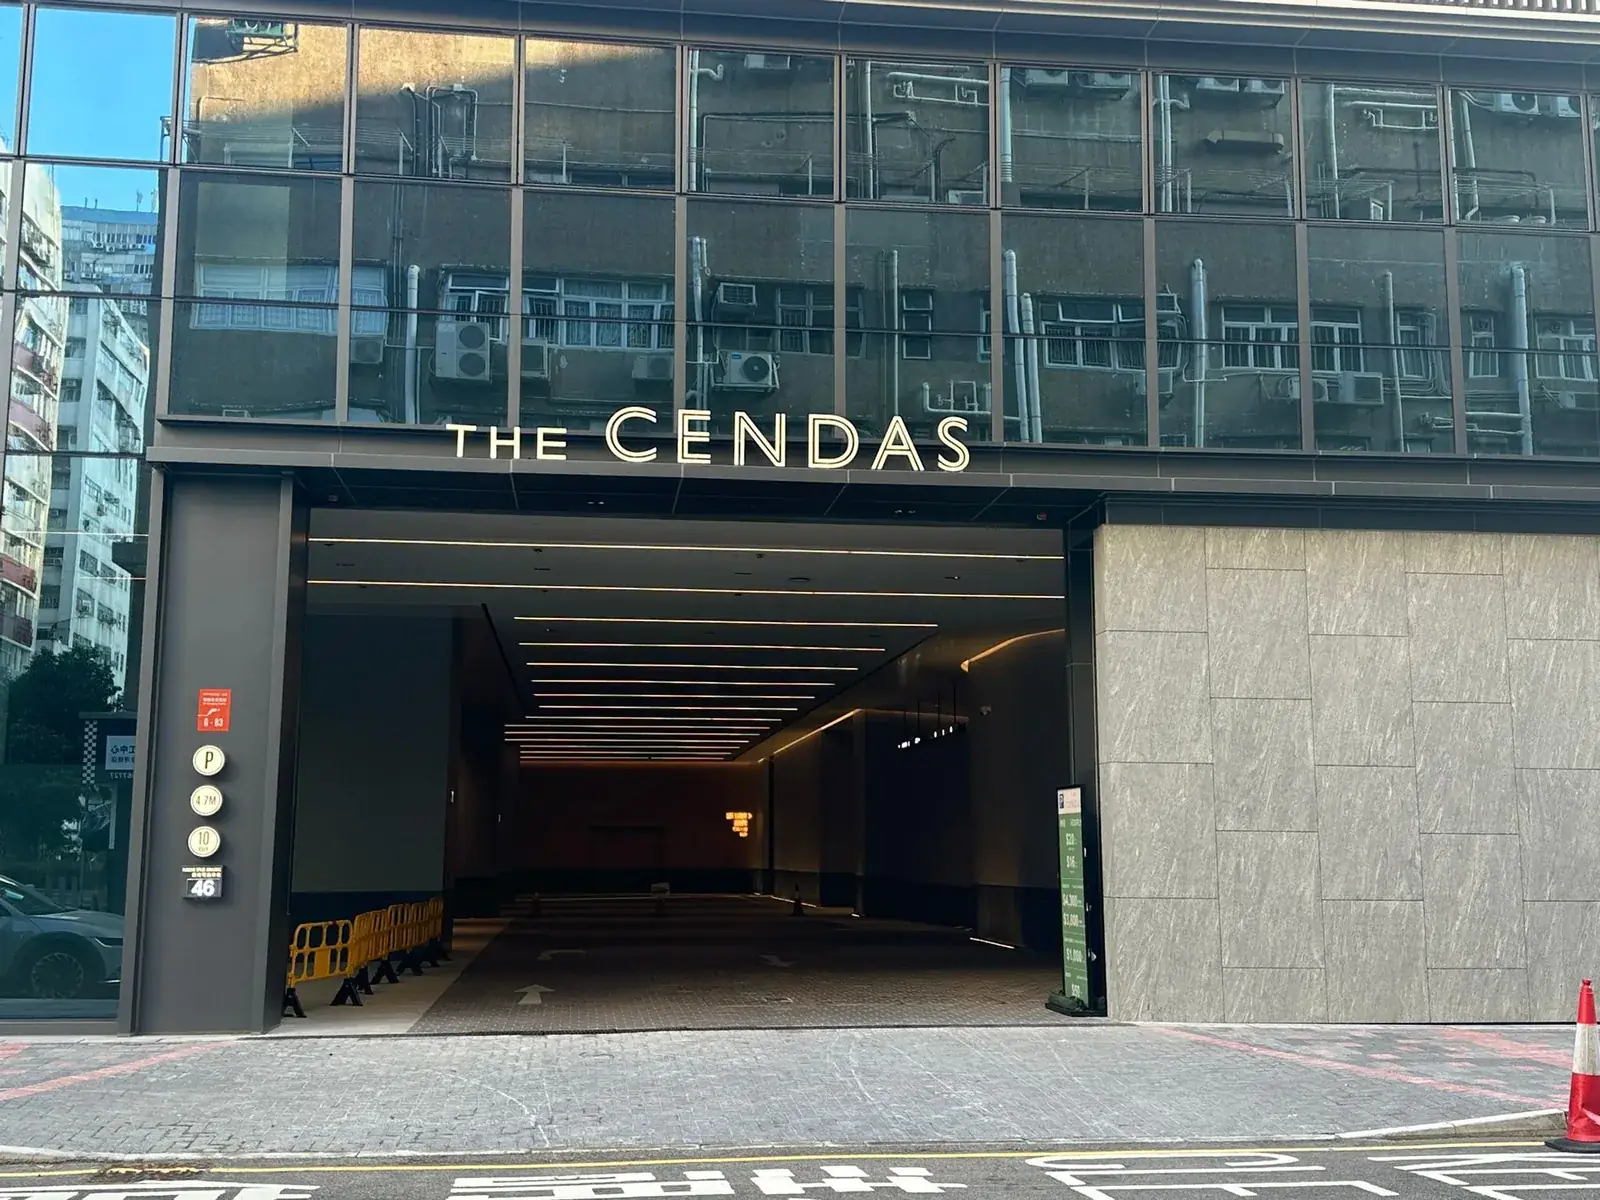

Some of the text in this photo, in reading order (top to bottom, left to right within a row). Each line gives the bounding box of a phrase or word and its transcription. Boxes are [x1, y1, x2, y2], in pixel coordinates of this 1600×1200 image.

[446, 406, 970, 472] THE CENDAS
[204, 751, 214, 770] P
[199, 831, 210, 845] 10
[191, 879, 215, 897] 46
